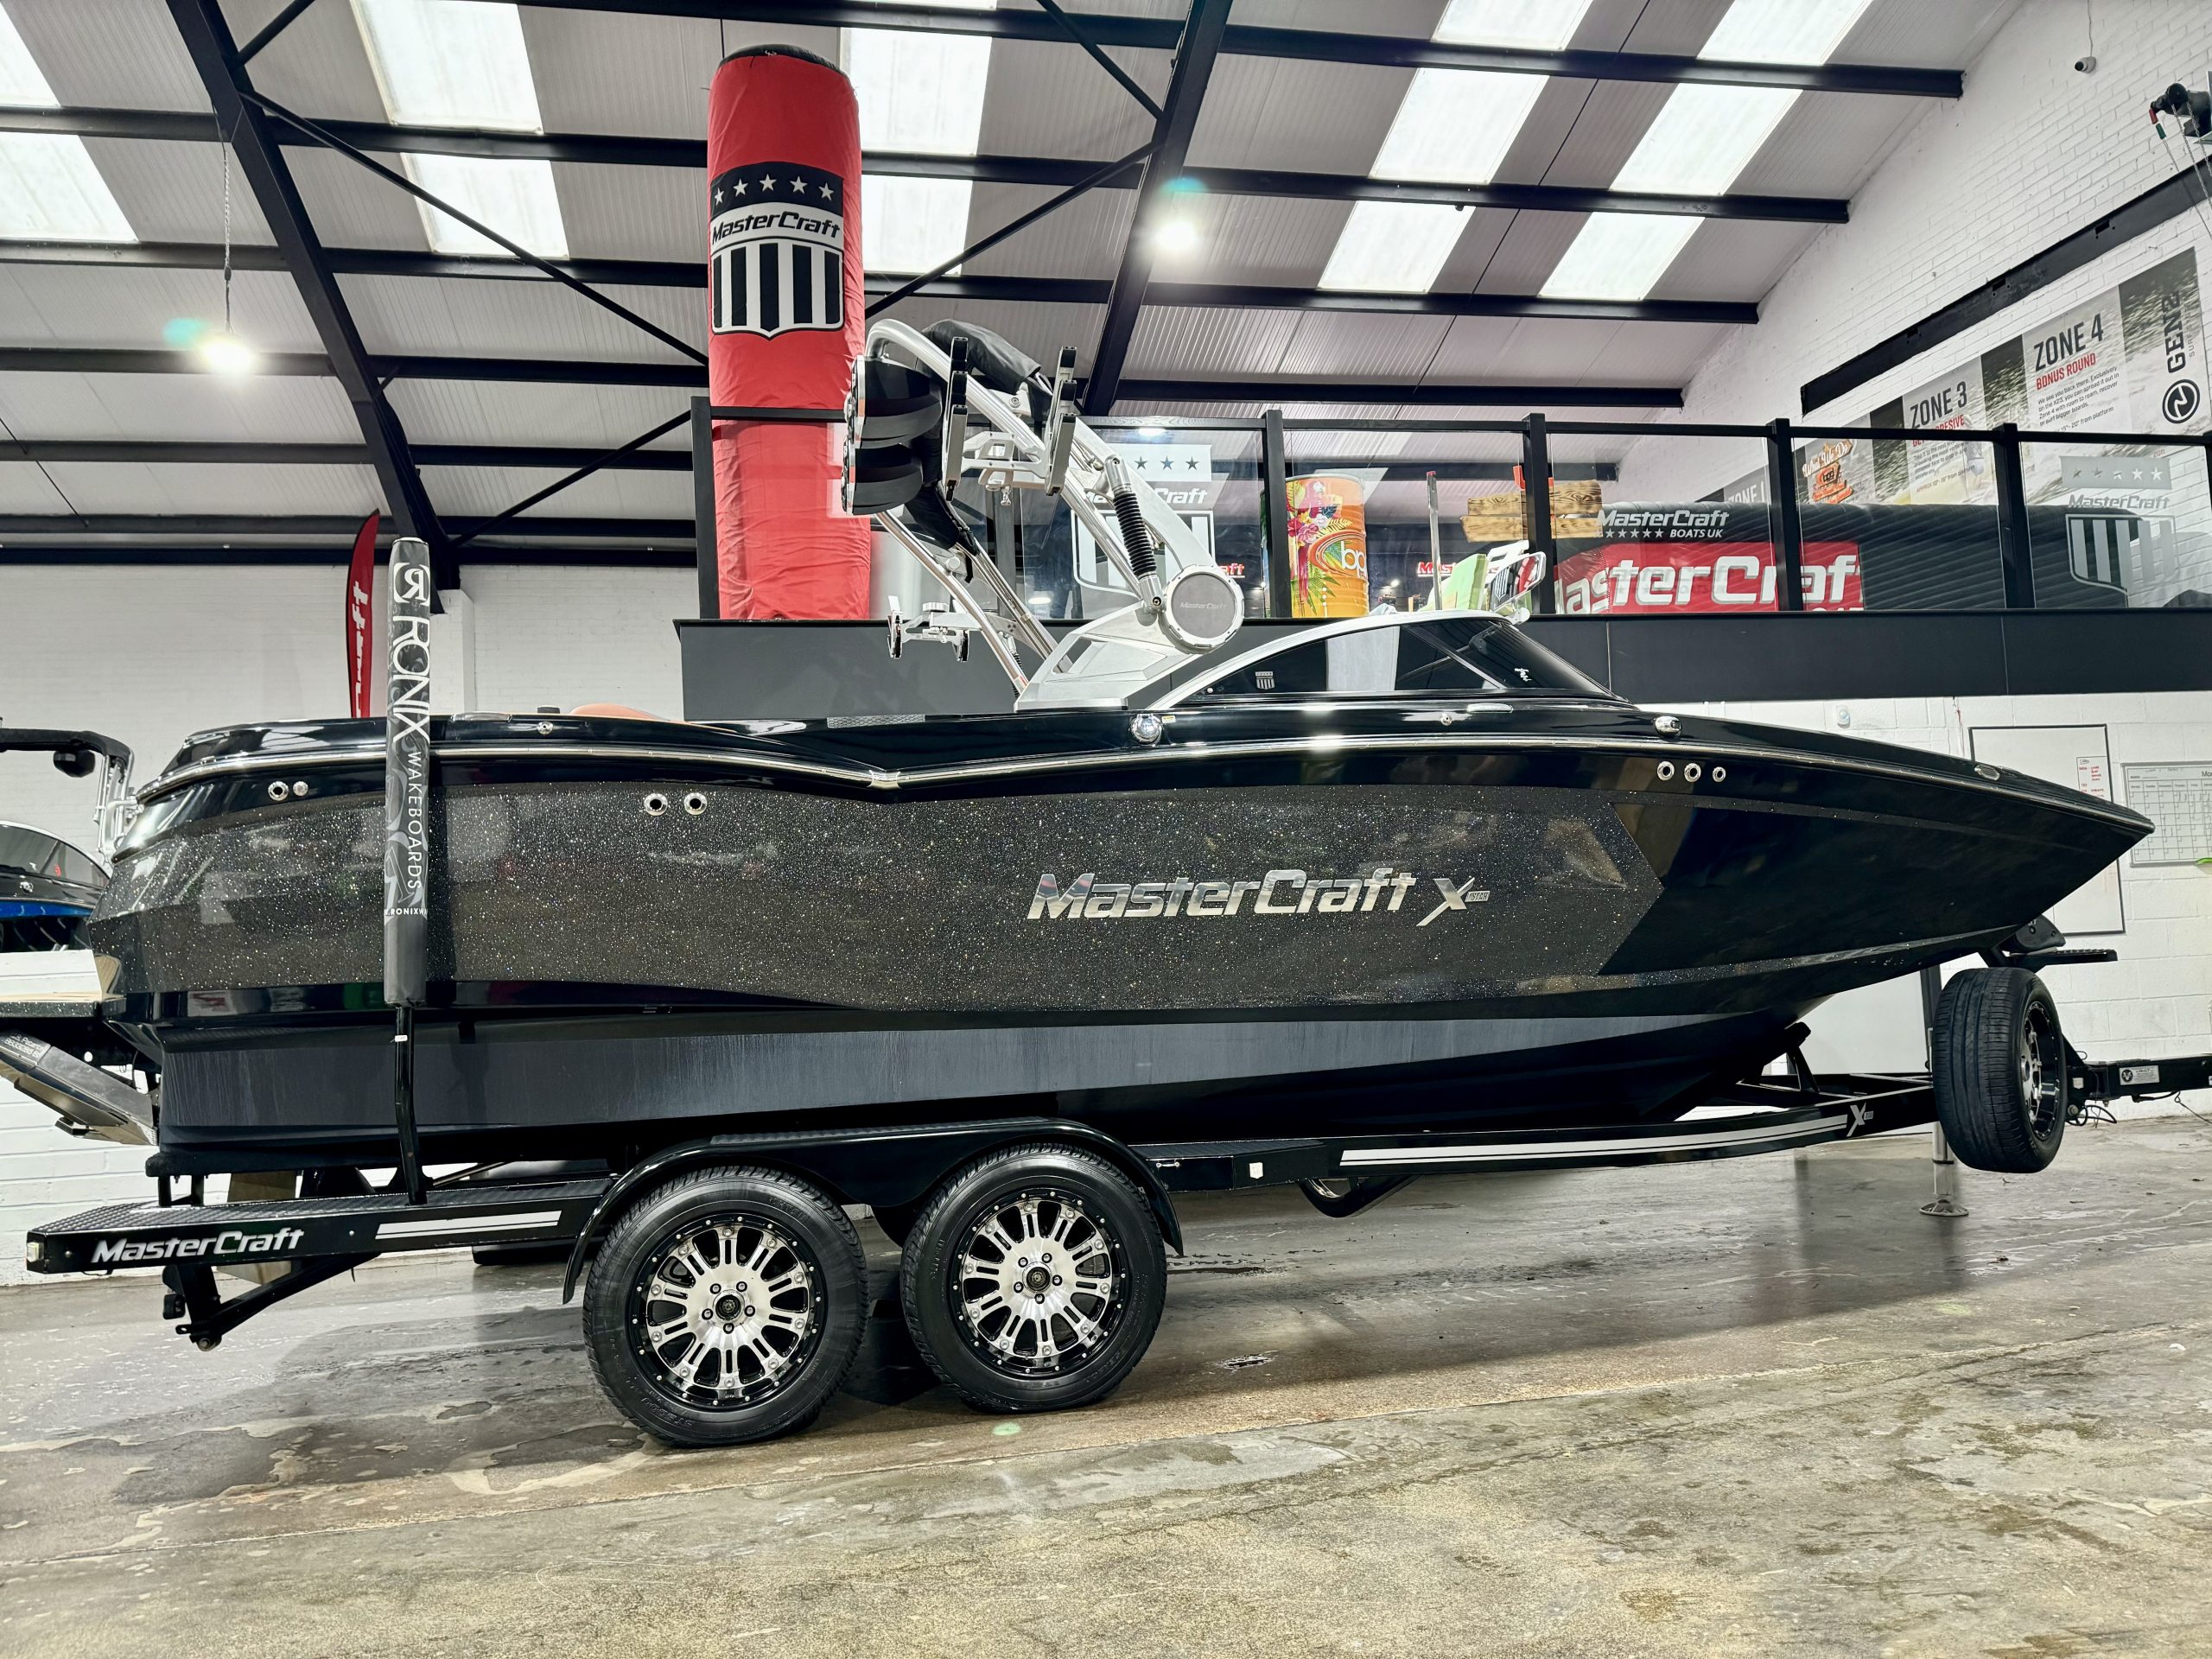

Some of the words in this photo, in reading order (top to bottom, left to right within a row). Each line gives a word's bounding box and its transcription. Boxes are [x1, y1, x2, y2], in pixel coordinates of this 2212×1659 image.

[712, 211, 840, 245] MasterCraft
[2034, 321, 2086, 372] ZONE
[2091, 313, 2103, 341] 4
[2036, 368, 2064, 391] BONUS
[2067, 353, 2096, 376] ROUND
[2099, 381, 2118, 393] recover
[1910, 388, 1953, 429] ZONE
[1956, 381, 1967, 408] 3
[2093, 406, 2114, 421] platform
[1595, 510, 1729, 527] MasterCraft
[2068, 494, 2170, 509] MasterCraft
[1669, 529, 1706, 538] BOATS
[1707, 529, 1723, 538] UK
[392, 615, 430, 745] RONIX
[408, 752, 422, 889] WAKEBOARDS
[1027, 869, 1416, 919] MasterCraft
[1416, 877, 1475, 926] X
[1847, 1103, 1866, 1137] X
[92, 1228, 304, 1263] MasterCraft
